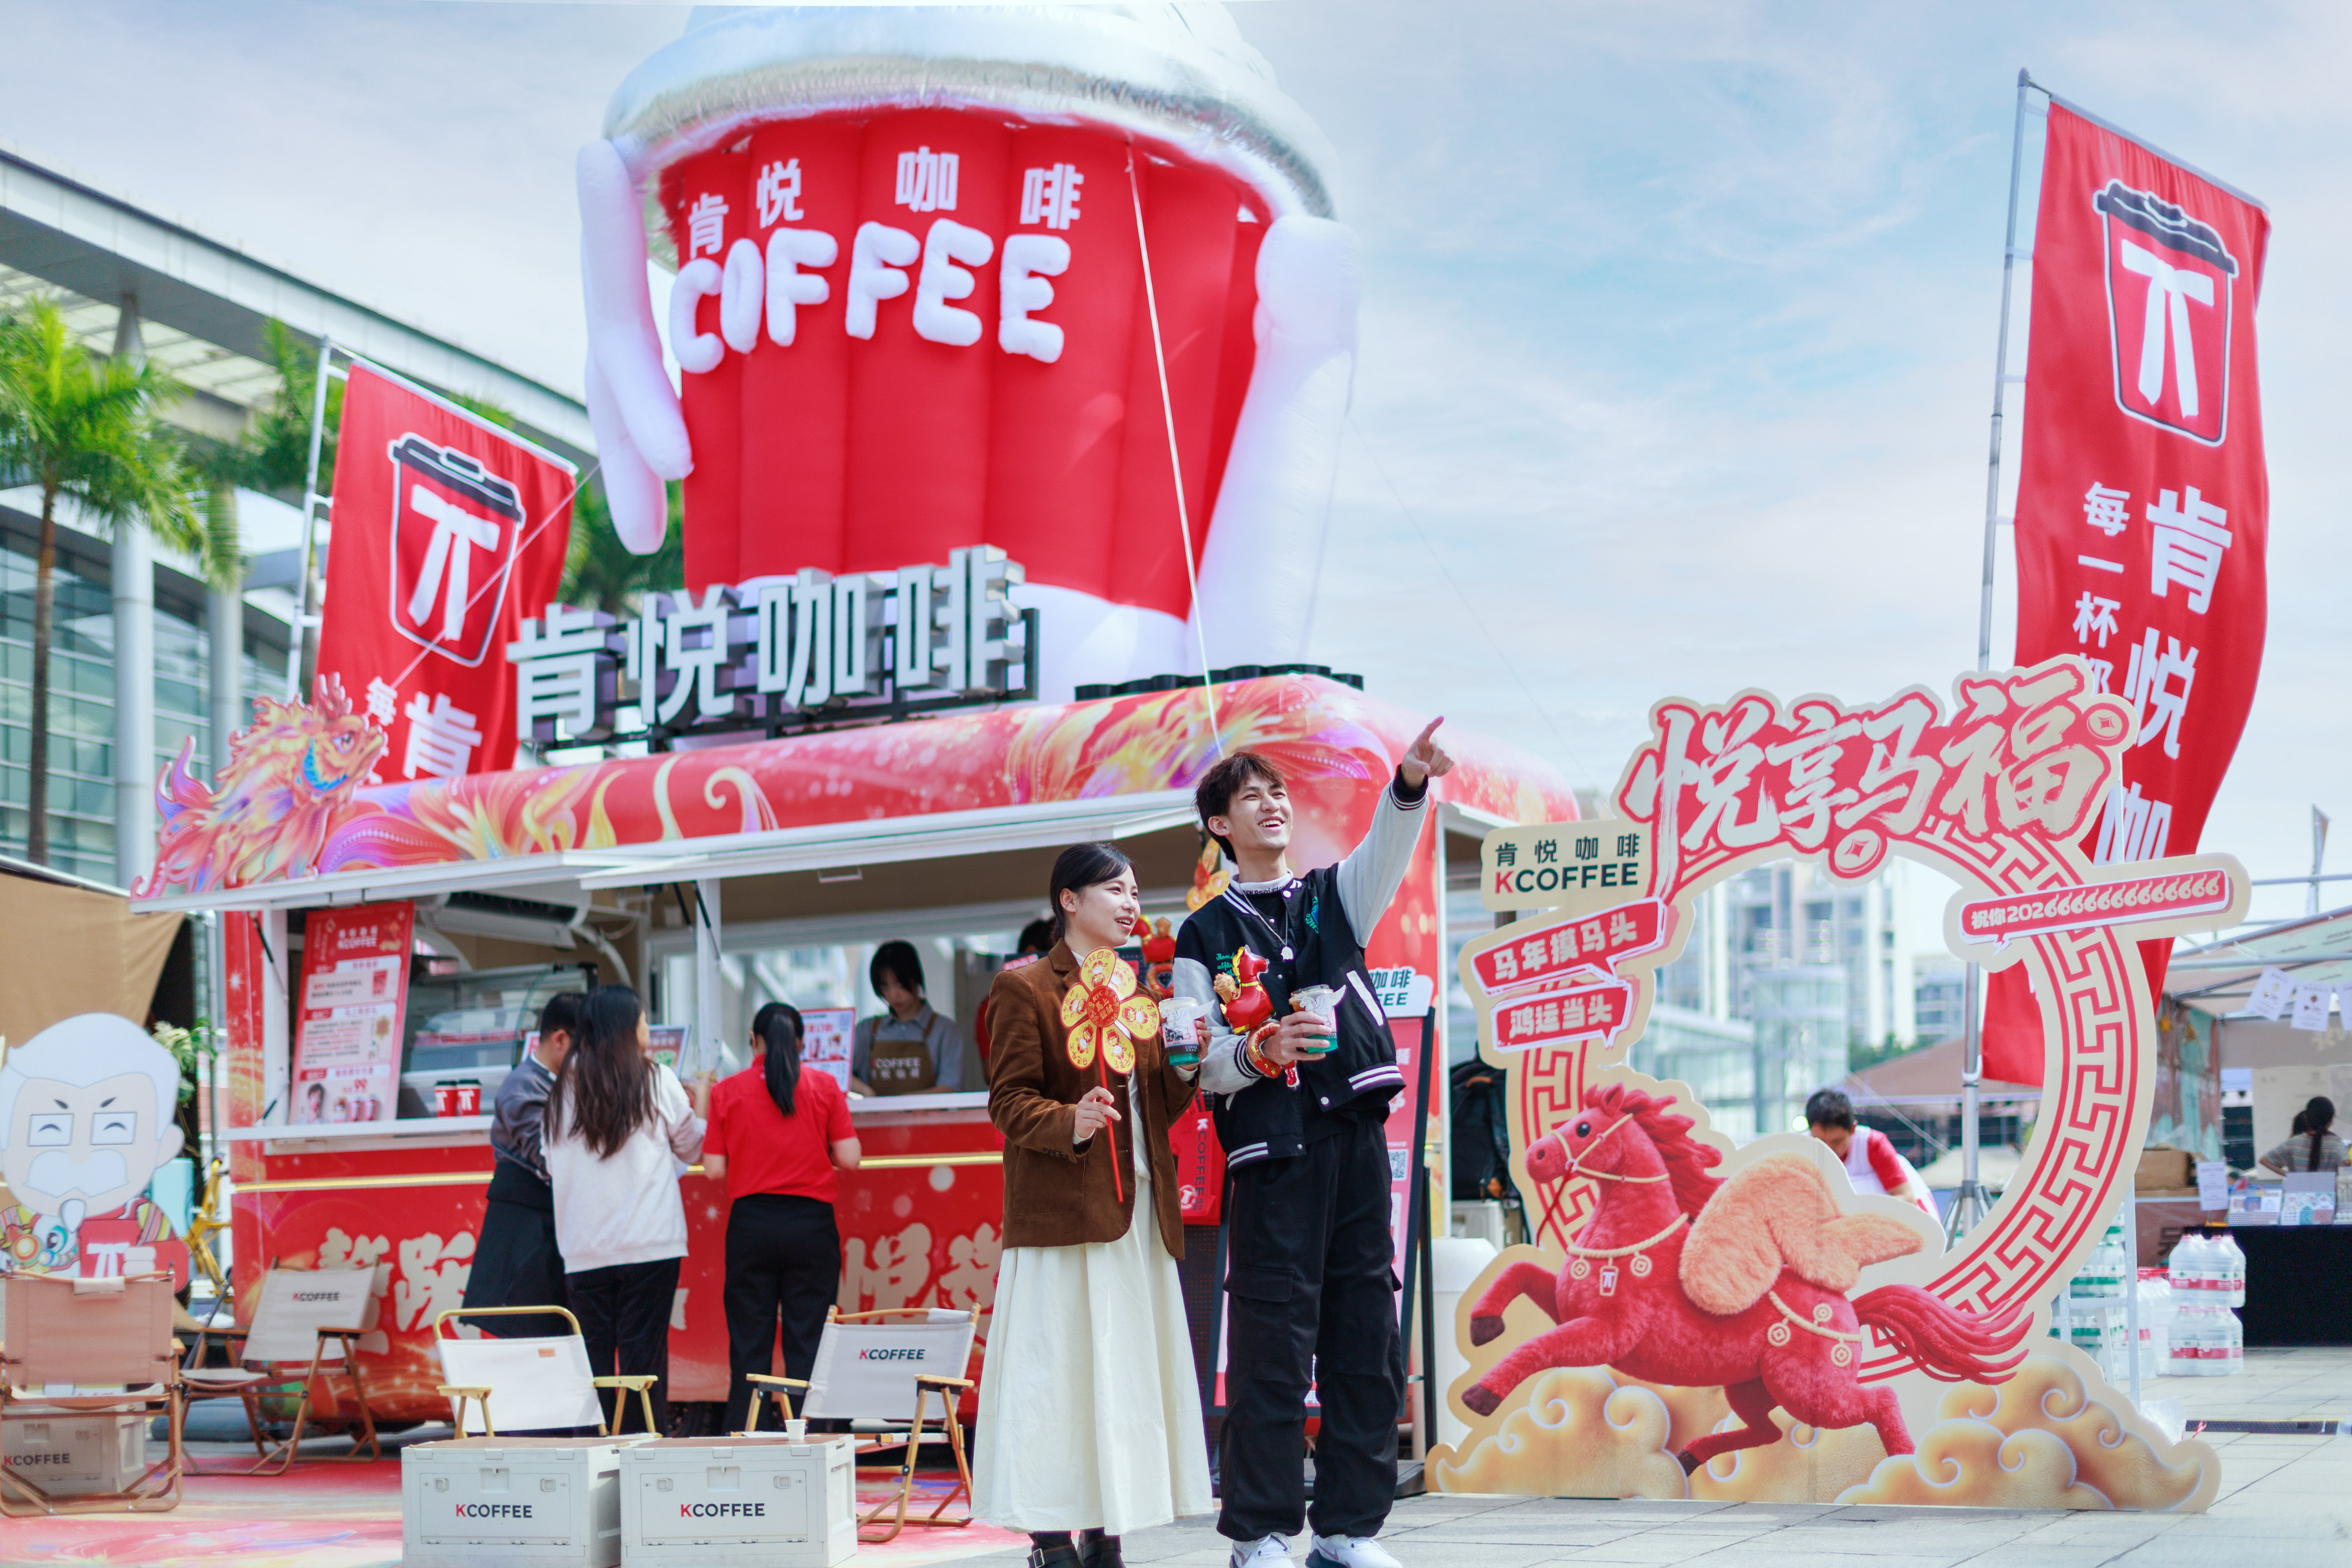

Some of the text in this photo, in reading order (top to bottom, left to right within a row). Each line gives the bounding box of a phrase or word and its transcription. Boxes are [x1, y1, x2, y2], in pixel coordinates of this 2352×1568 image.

[688, 146, 1085, 259] 肯悦咖啡
[669, 219, 1072, 374] COFFEE
[506, 545, 1025, 741] 肯悦咖啡
[1624, 663, 2105, 898] 悦享马福
[1495, 833, 1640, 867] 肯悦咖啡
[1494, 862, 1639, 894] KCOFFEE
[1493, 912, 1637, 980] 马年摸马头
[1092, 990, 1104, 1002] KFC
[1370, 970, 1412, 990] 咖啡
[1509, 994, 1612, 1038] 鸿运当头
[1196, 1118, 1208, 1196] KCOFFEE
[292, 1291, 340, 1302] KCOFFEE
[859, 1348, 925, 1360] KCOFFEE
[3, 1453, 70, 1467] KCOFFEE
[455, 1503, 532, 1519] KCOFFEE
[680, 1502, 765, 1518] KCOFFEE
